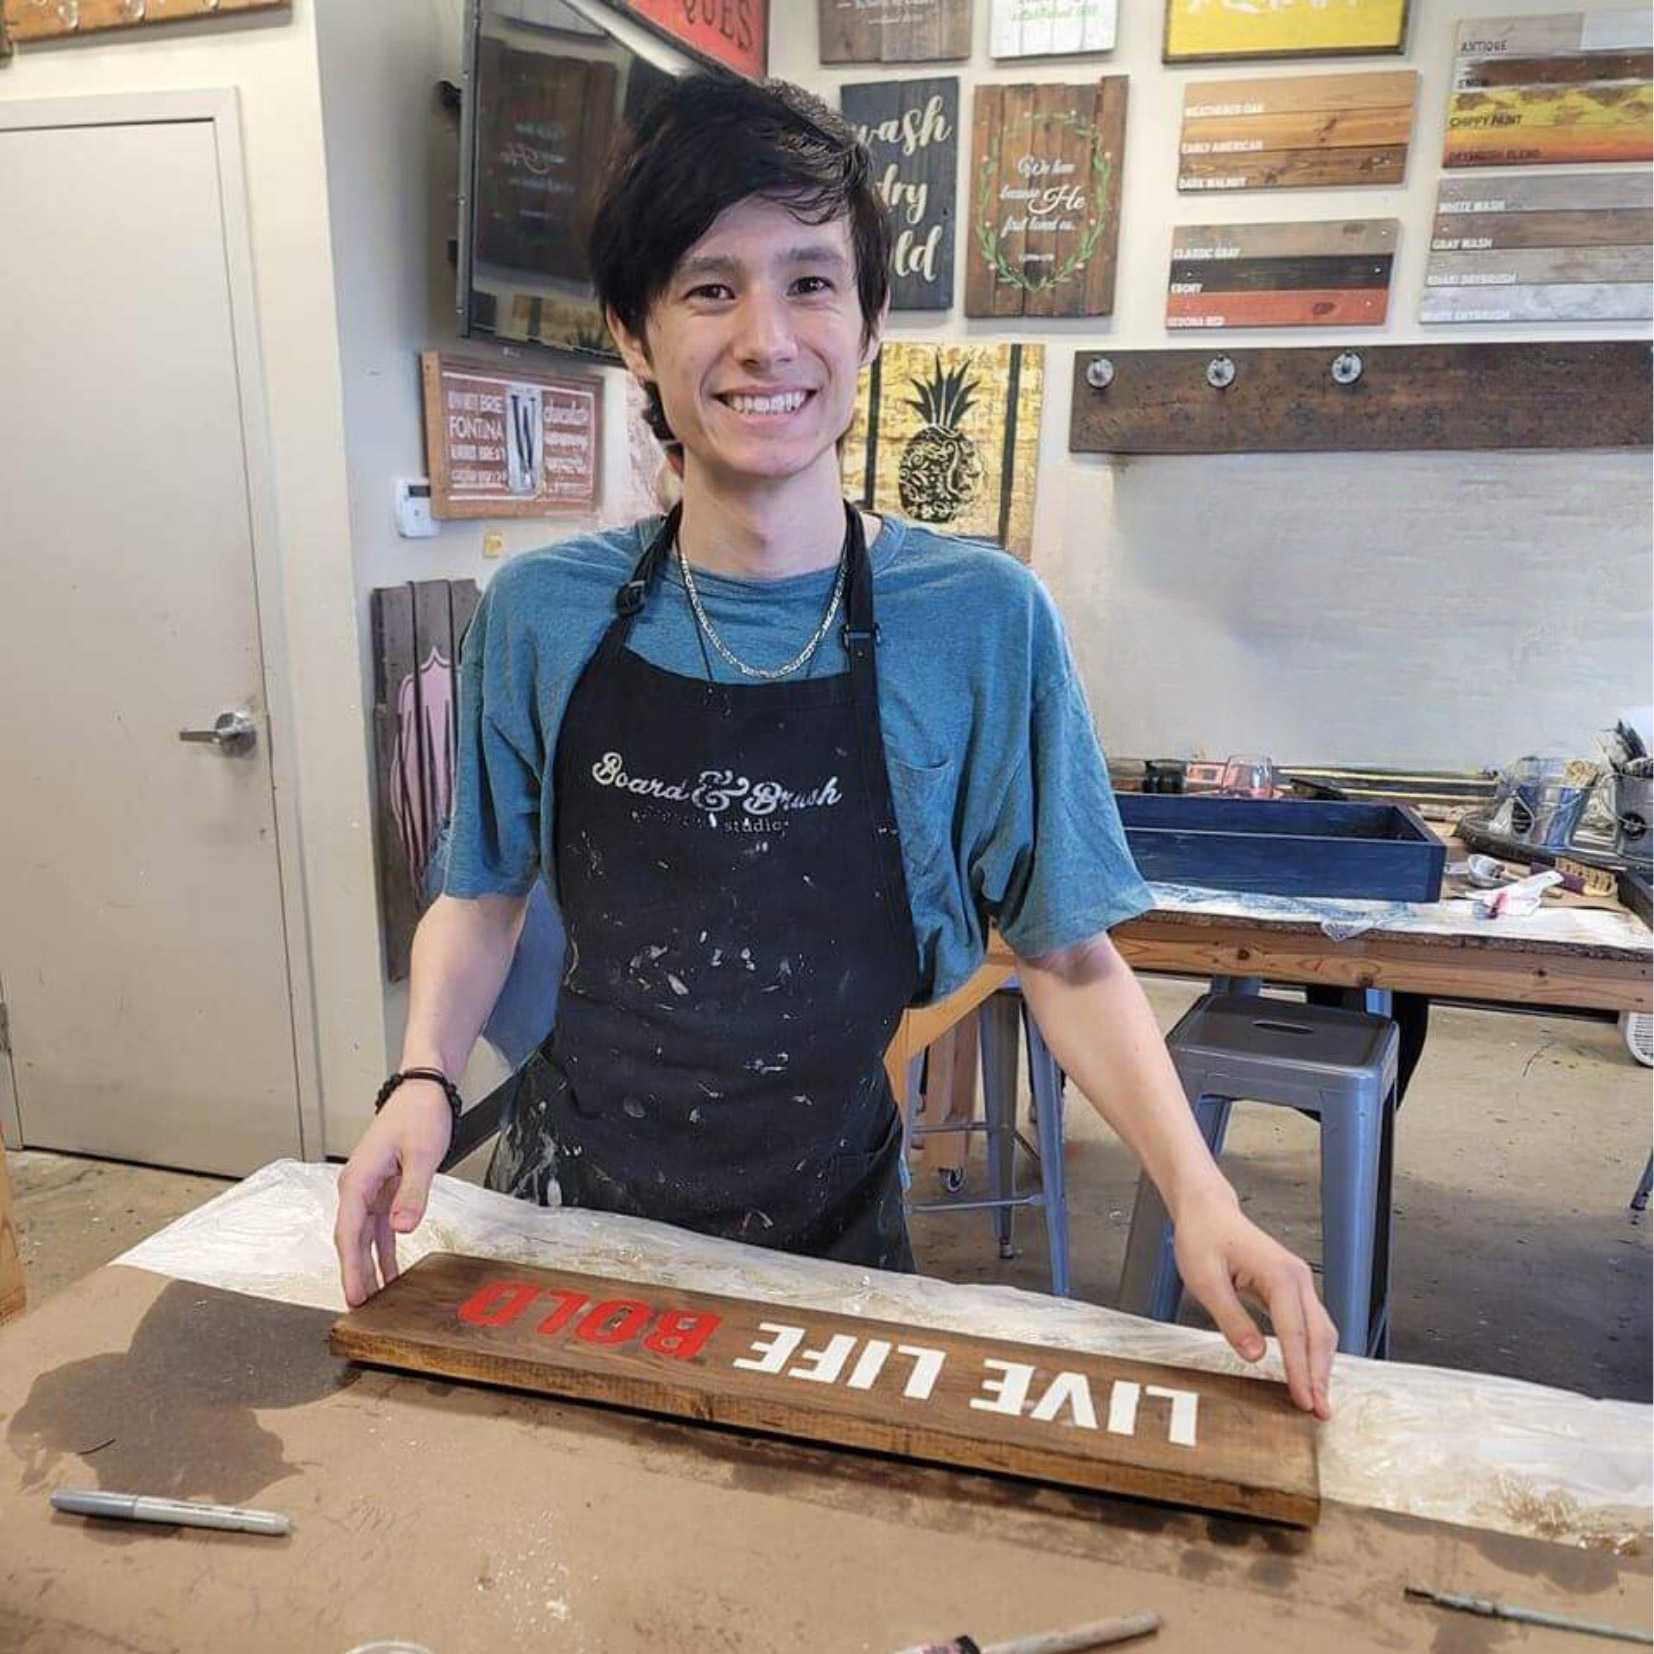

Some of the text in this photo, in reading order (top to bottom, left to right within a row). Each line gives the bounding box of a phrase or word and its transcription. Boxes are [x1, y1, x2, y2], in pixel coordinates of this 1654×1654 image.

[1461, 39, 1508, 52] ANTIQUE
[1449, 113, 1523, 128] CHIPPY PAINT
[1181, 140, 1264, 153] EARLY AMERICAN
[1179, 177, 1247, 189] DARK WALNUT
[1028, 184, 1086, 215] He
[1438, 200, 1505, 213] WHITE WASH
[1431, 238, 1493, 249] GRAY WASH
[894, 225, 943, 282] ld
[1174, 247, 1240, 259] CLASSIC GRAY
[1171, 283, 1203, 293] EBONY
[1205, 315, 1225, 327] RED
[450, 415, 504, 441] FONTINA
[592, 752, 692, 801] Board
[692, 770, 749, 812] &
[743, 776, 842, 815] Brush
[456, 1277, 1199, 1447] LIVE LIFE BOLD
